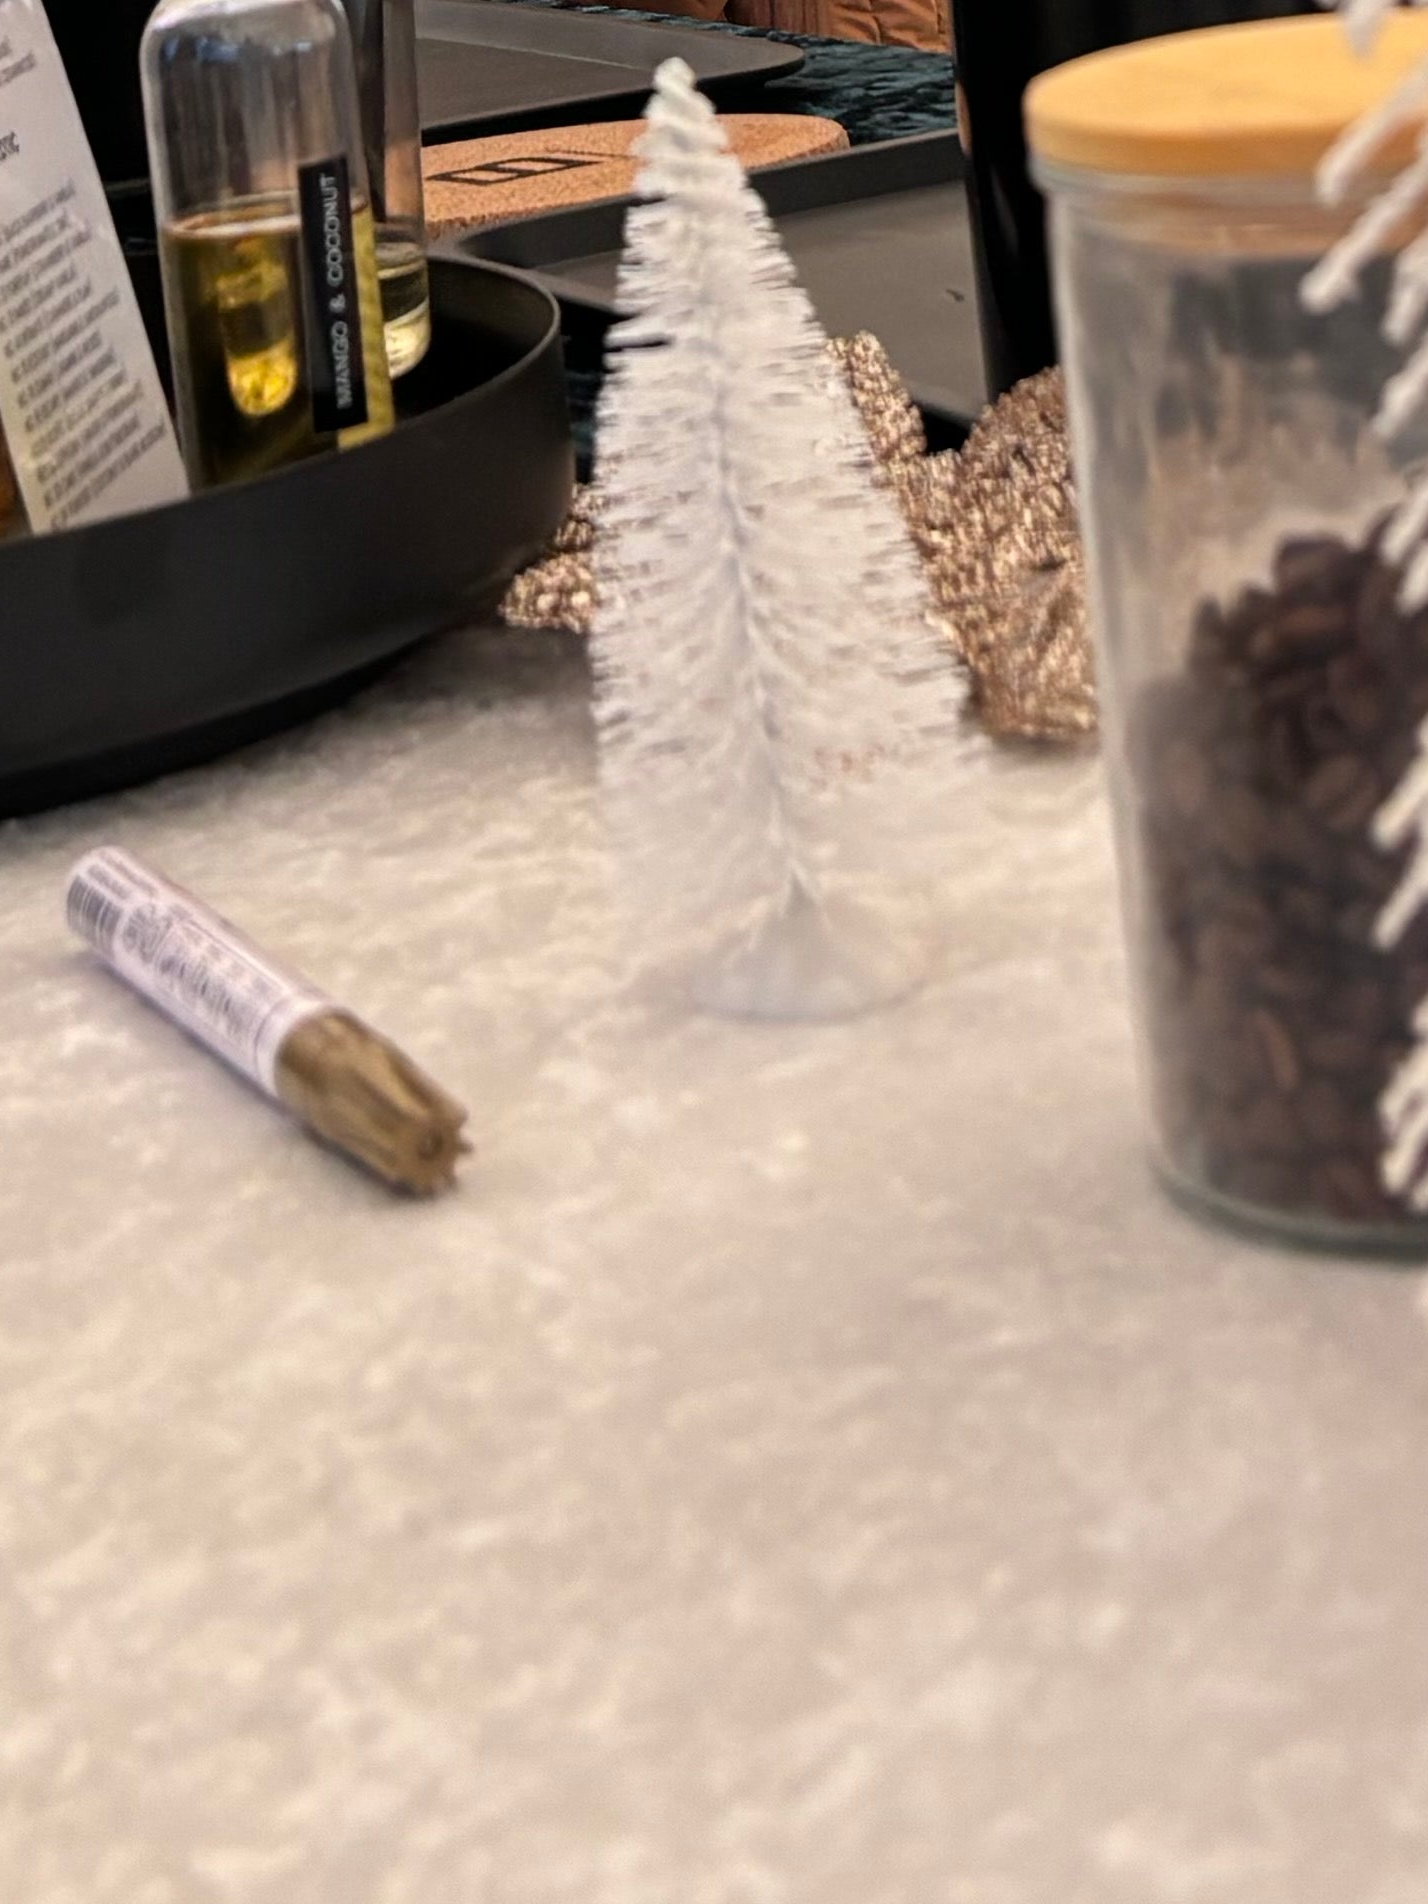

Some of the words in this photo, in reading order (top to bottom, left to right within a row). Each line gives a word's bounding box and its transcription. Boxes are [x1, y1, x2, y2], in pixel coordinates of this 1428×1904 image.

[318, 172, 346, 289] COCONUT
[327, 292, 347, 316] &
[326, 319, 355, 411] MANGO
